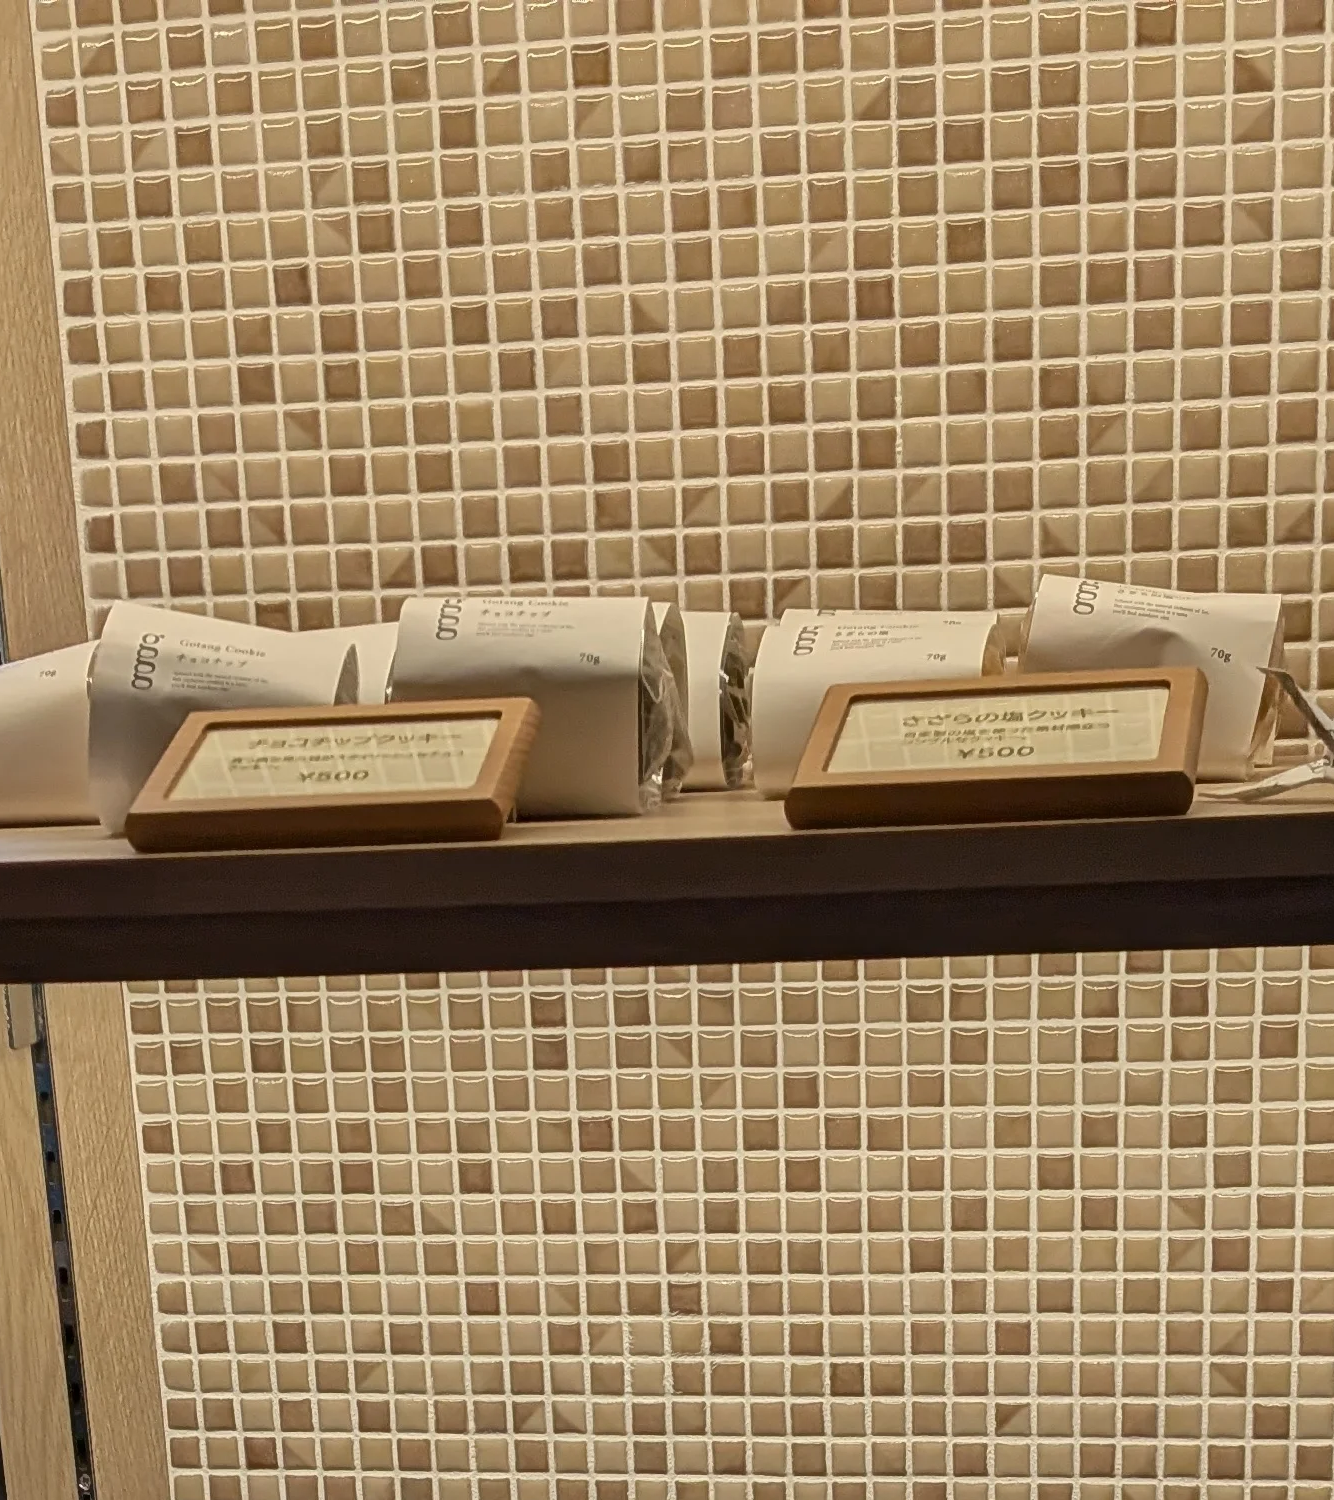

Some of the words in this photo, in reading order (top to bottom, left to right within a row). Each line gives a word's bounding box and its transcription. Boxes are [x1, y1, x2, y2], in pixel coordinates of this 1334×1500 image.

[579, 652, 600, 665] 70g
[1210, 647, 1232, 663] 70g
[957, 746, 1035, 759] ¥500
[299, 769, 369, 783] ¥500
